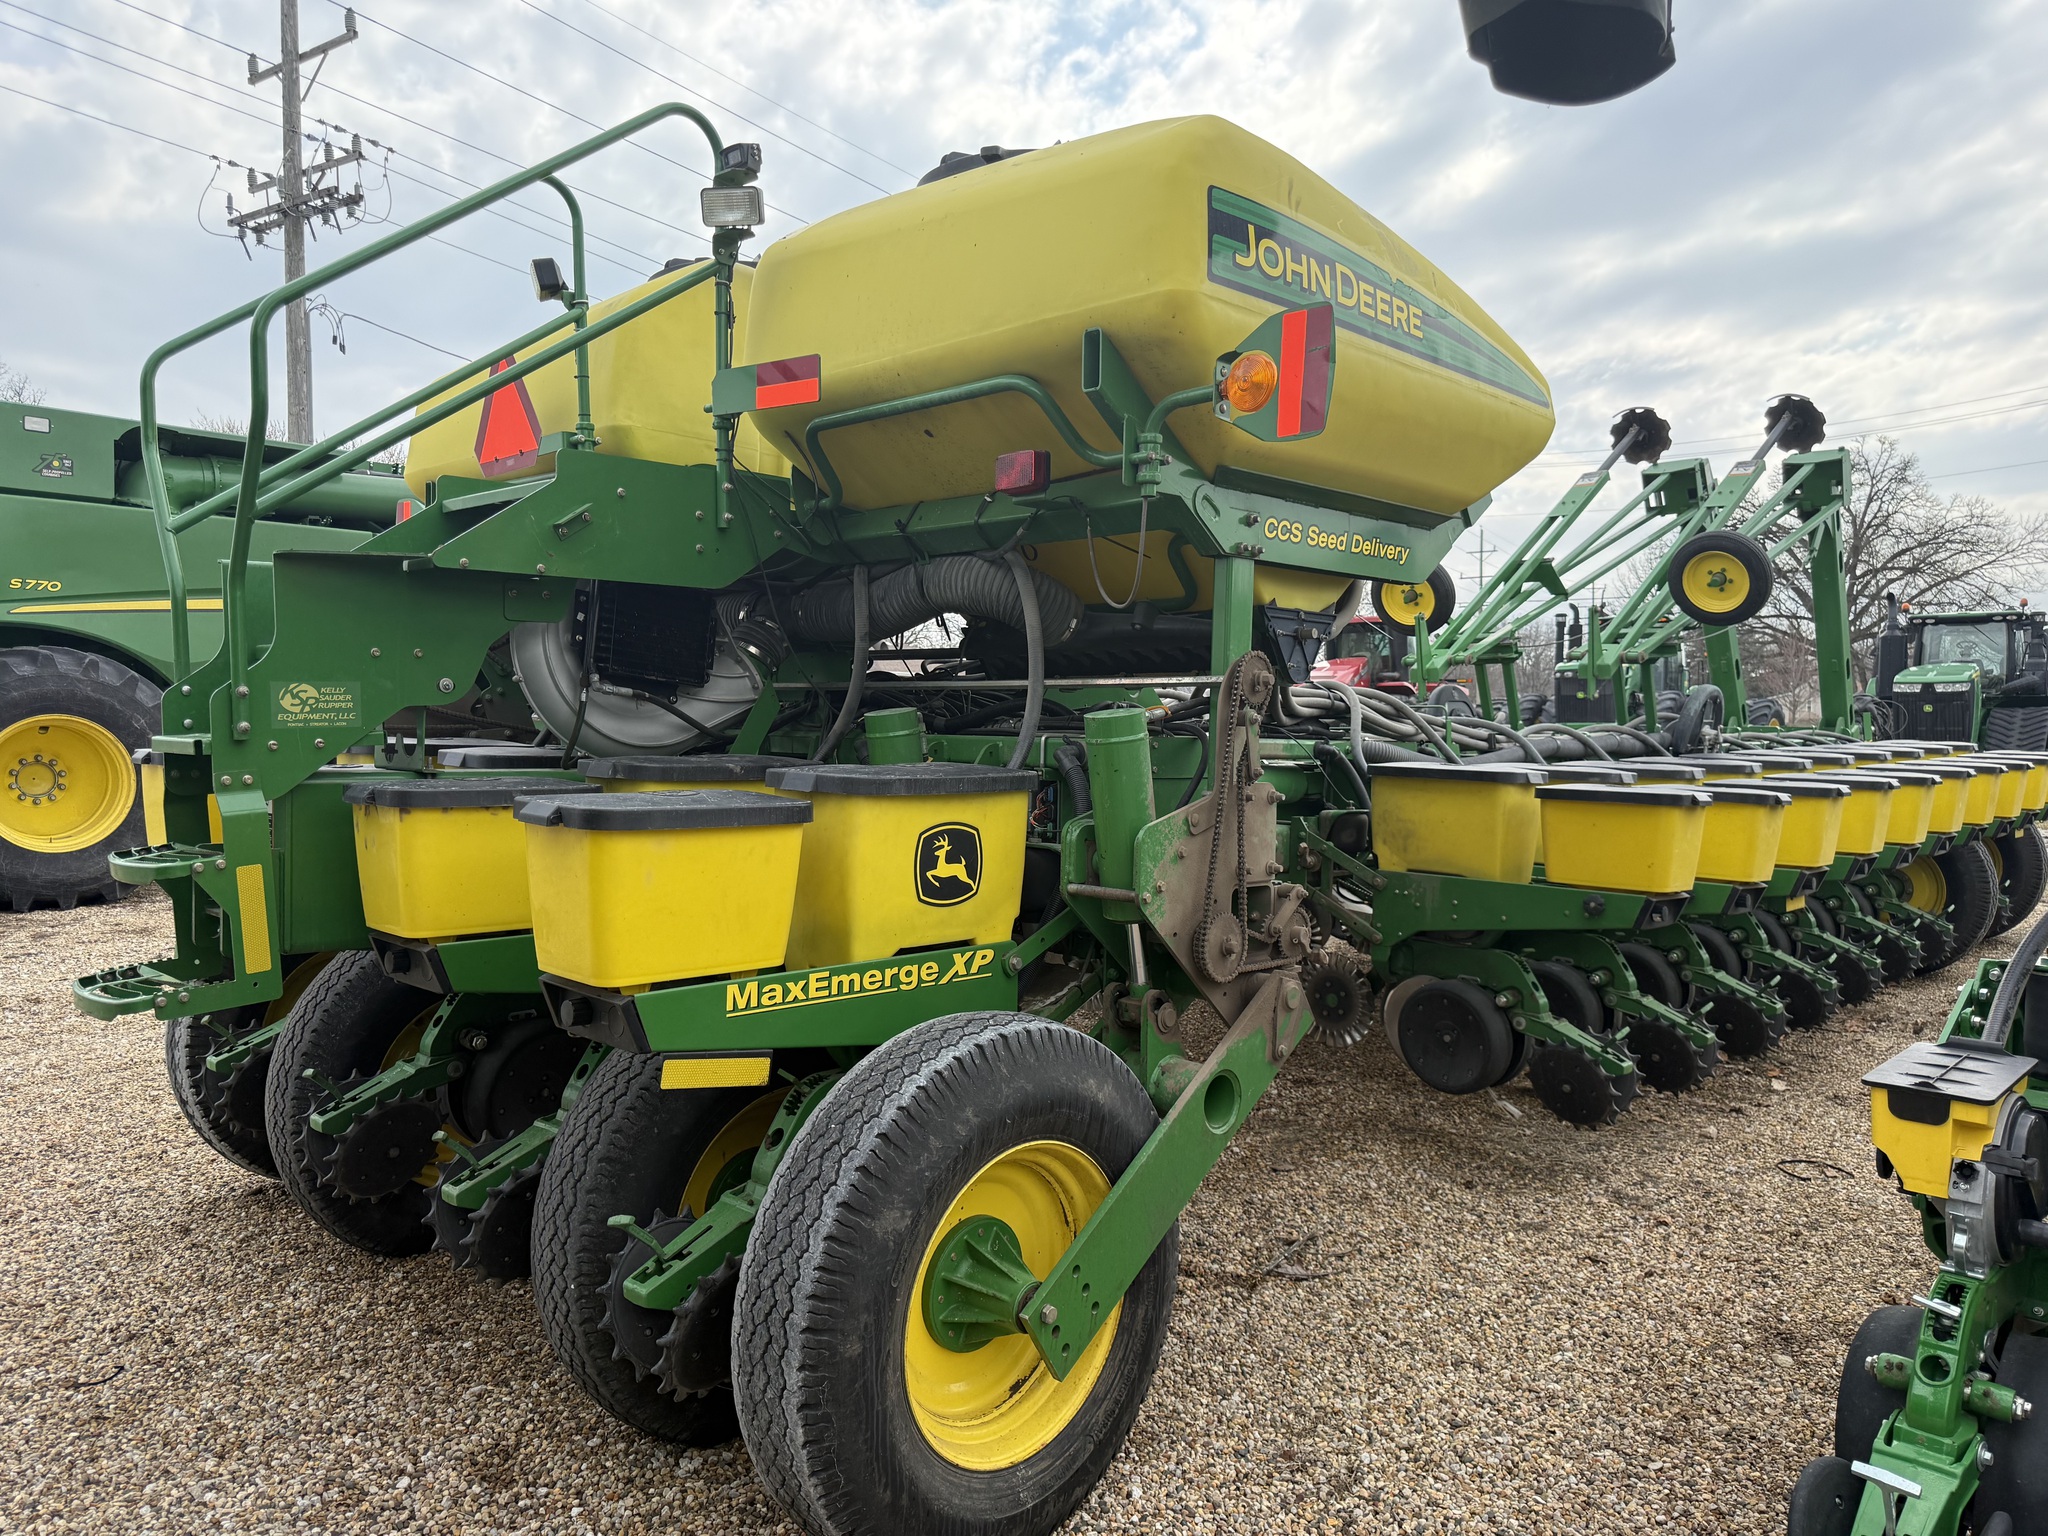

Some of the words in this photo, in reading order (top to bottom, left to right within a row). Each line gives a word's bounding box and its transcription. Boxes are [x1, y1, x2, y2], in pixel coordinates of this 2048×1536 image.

[1235, 223, 1331, 299] JOHN
[1335, 261, 1424, 339] DEERE
[1264, 517, 1303, 543] CCS
[1306, 525, 1348, 551] Seed
[1351, 534, 1410, 565] Delivery
[277, 713, 338, 722] EQUIPMENT,
[338, 712, 357, 720] LLC
[725, 960, 940, 1012] MaxEmerge
[938, 948, 995, 985] XP
